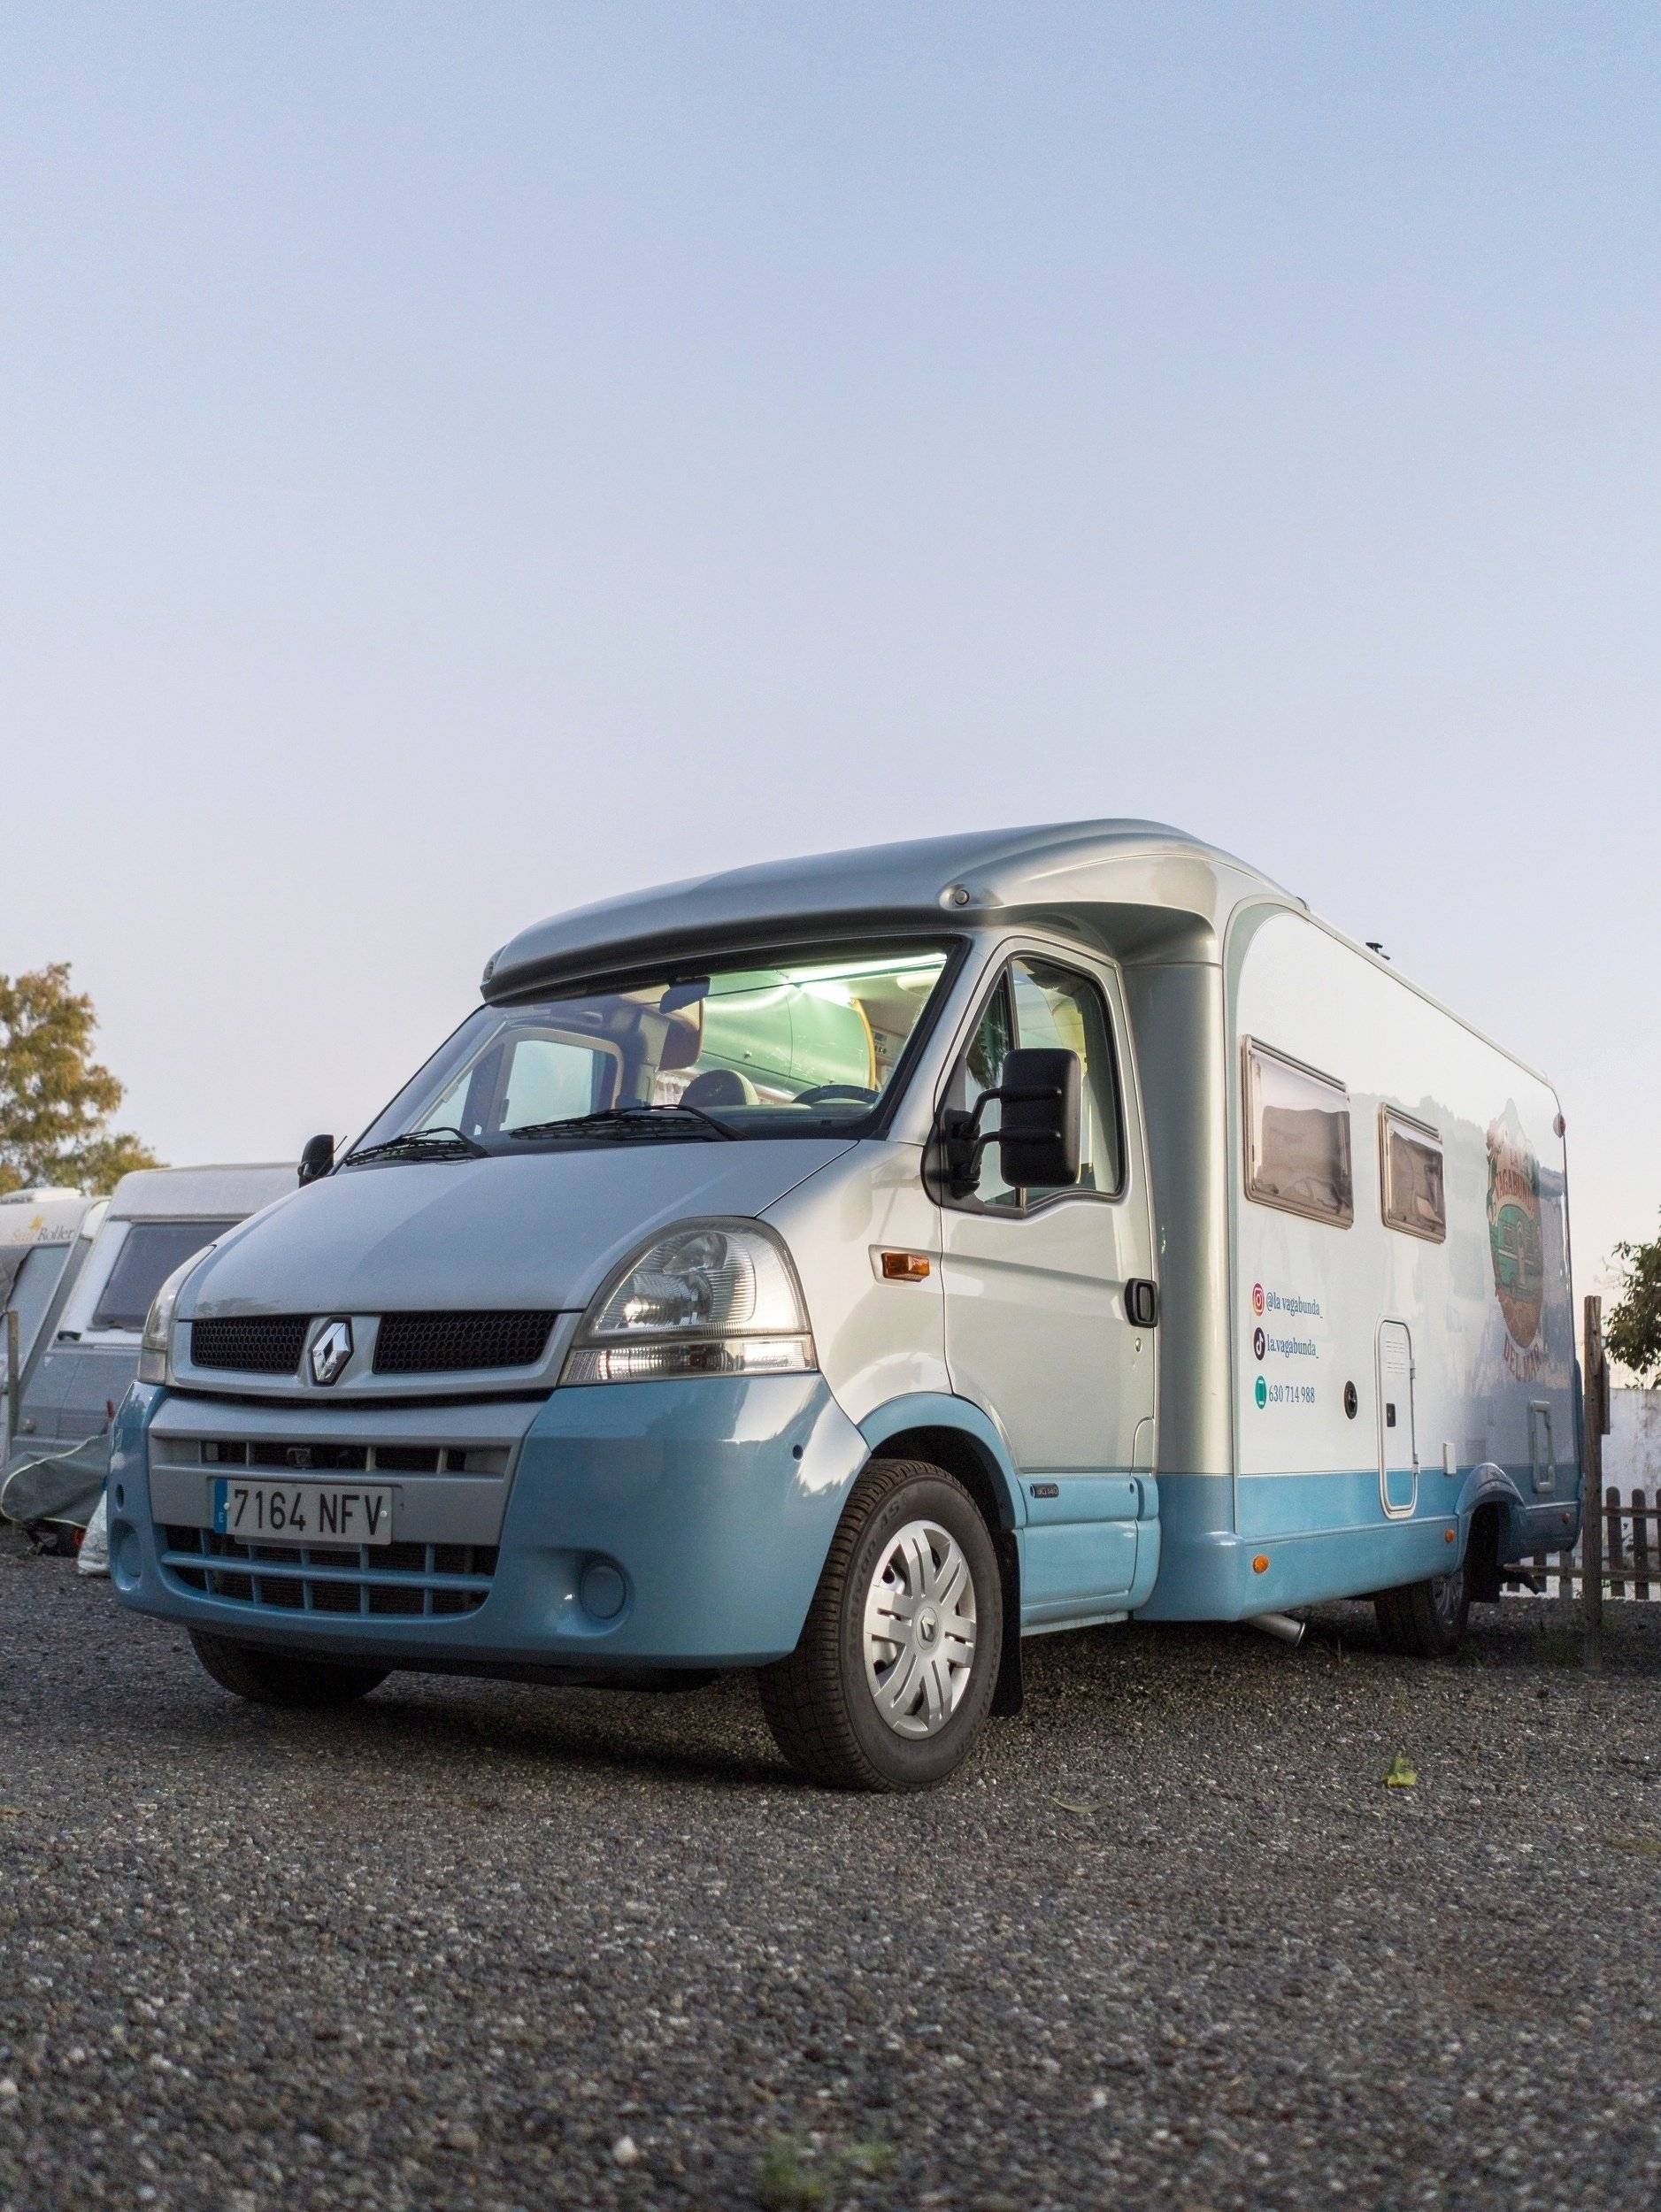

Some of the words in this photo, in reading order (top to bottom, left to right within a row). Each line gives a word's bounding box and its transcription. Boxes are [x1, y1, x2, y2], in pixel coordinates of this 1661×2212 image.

[1266, 1292, 1280, 1312] @la
[1269, 1385, 1283, 1402] 630
[1285, 1386, 1300, 1403] 714
[1301, 1386, 1315, 1403] 988
[235, 1489, 306, 1532] 7164
[319, 1494, 383, 1535] NFV
